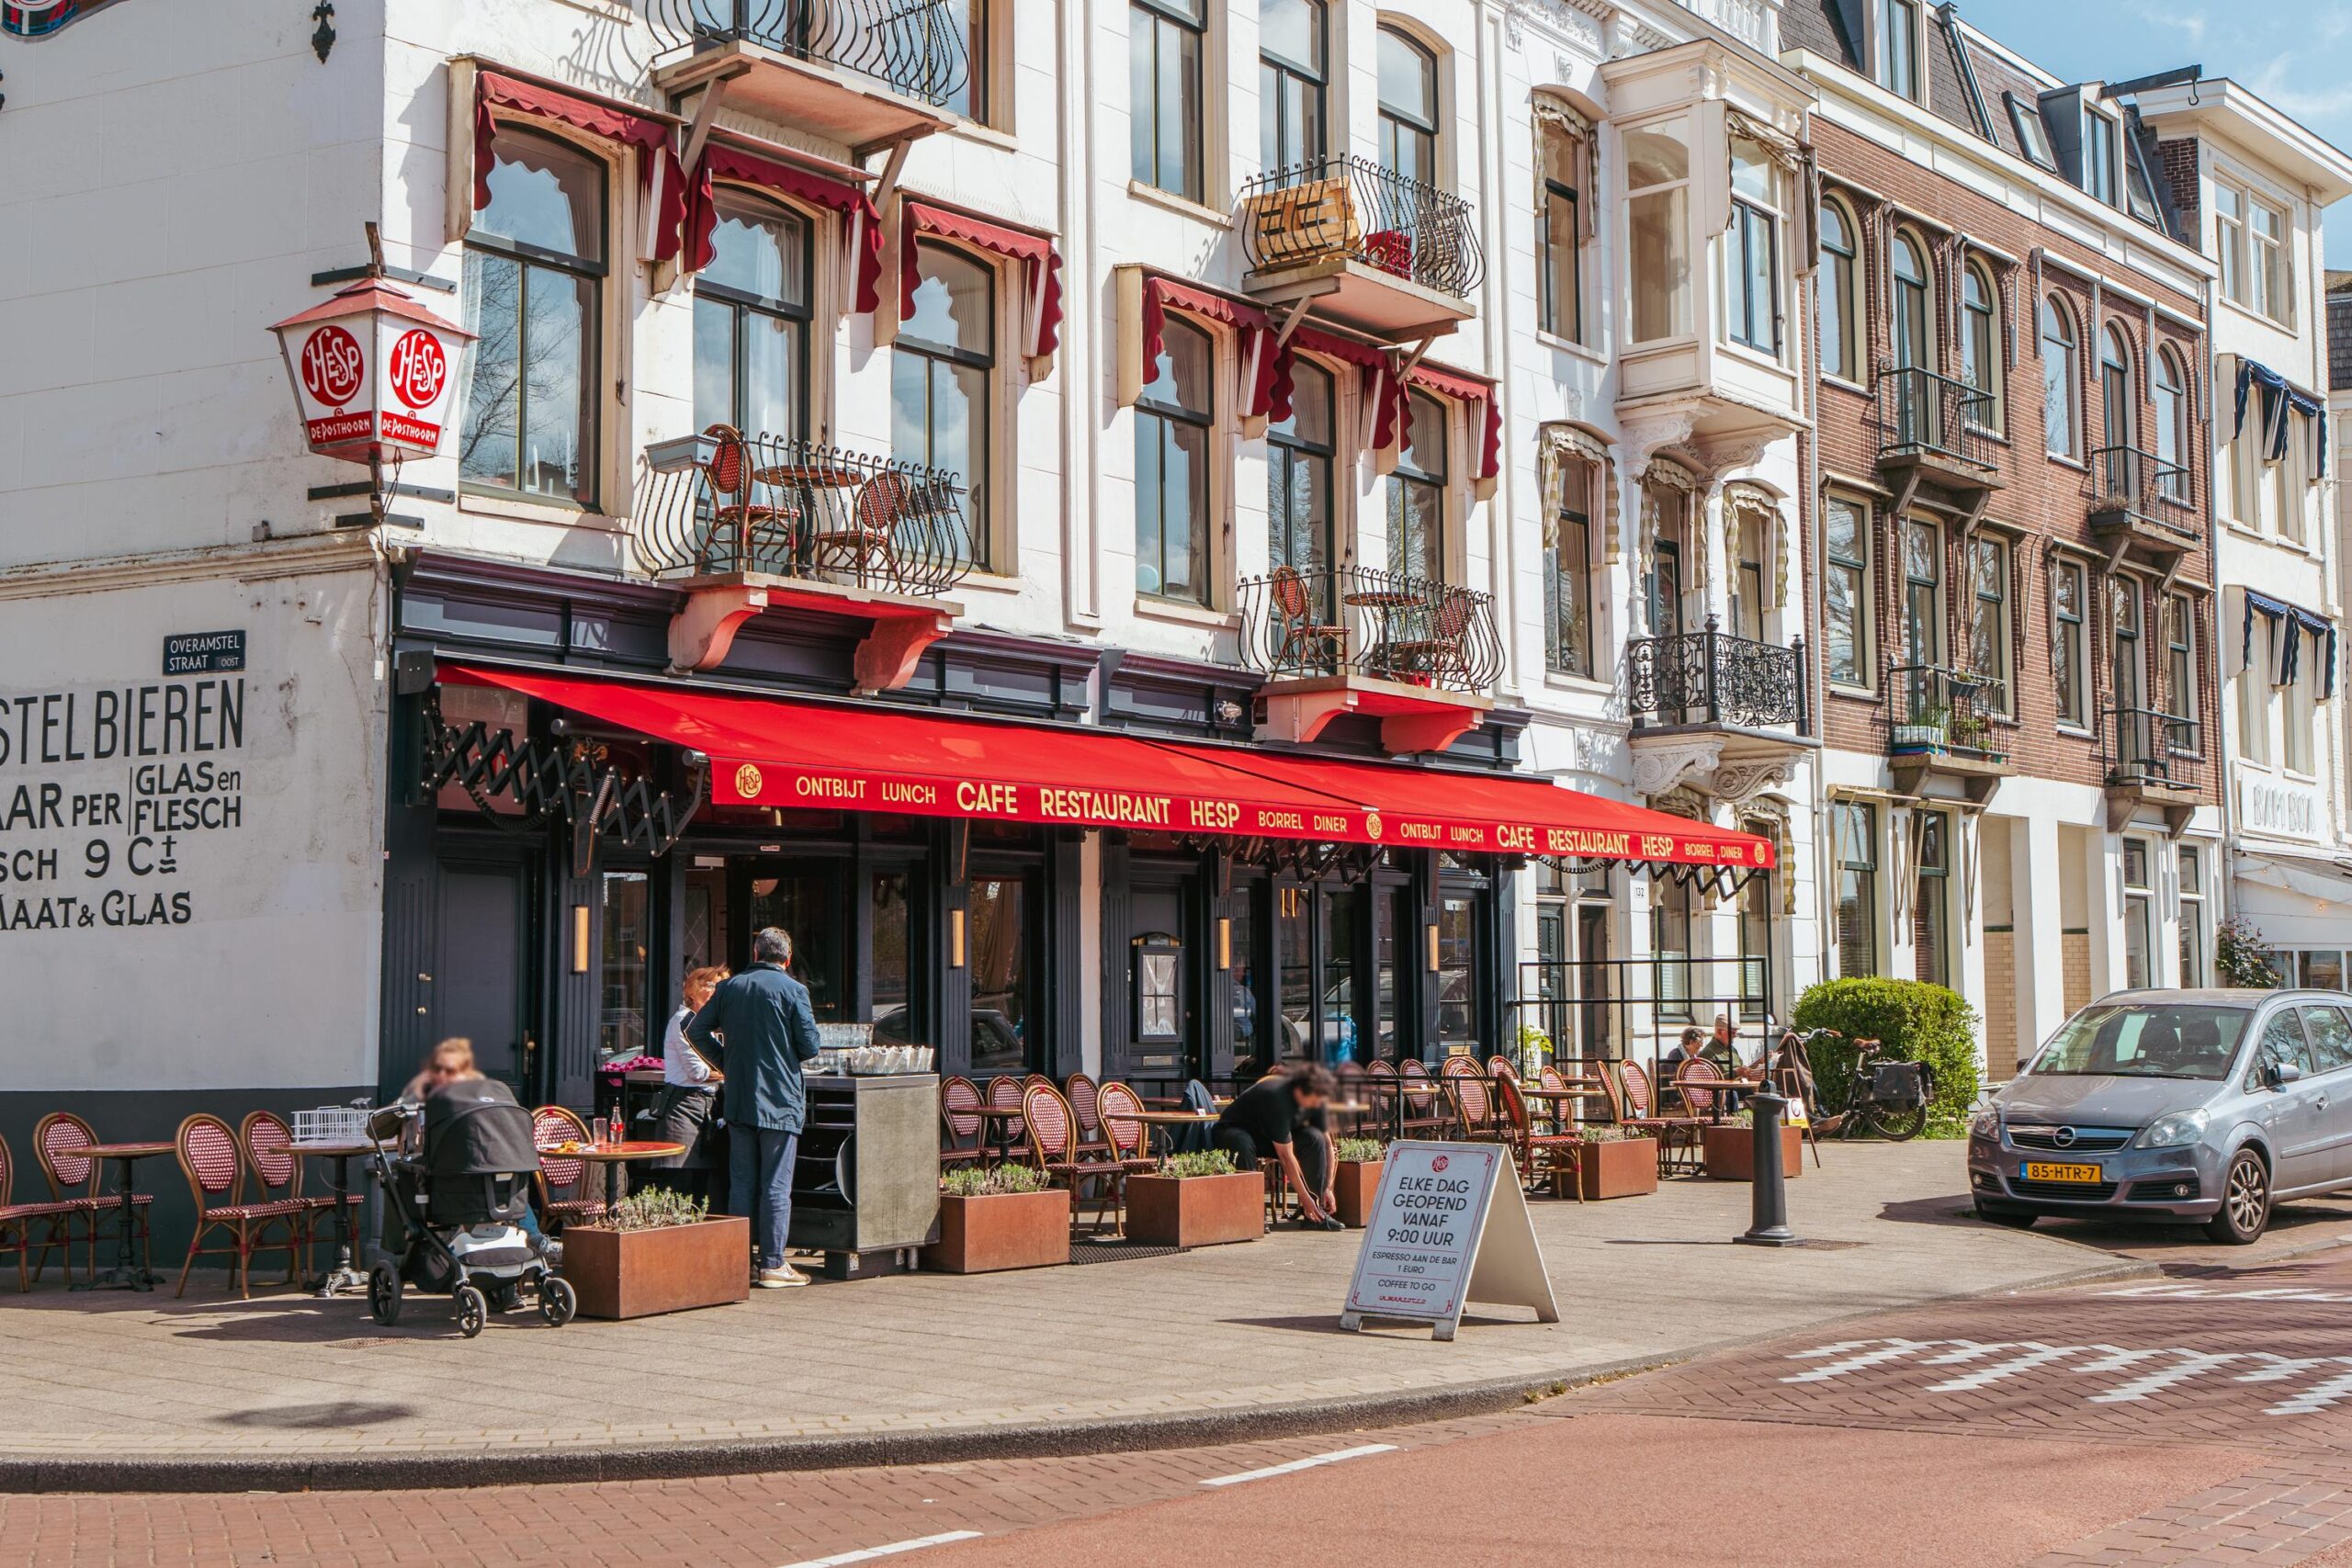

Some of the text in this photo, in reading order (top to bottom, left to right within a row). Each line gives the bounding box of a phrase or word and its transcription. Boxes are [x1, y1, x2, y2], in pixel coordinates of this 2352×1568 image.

[305, 327, 359, 400] HESP
[391, 331, 444, 406] HESP
[170, 635, 240, 654] OVERAMSTEL
[169, 655, 240, 671] STRAAT OOST
[0, 761, 241, 831] AR PER GLAS en
[796, 775, 1348, 833] ONTBIJT LUNCH CAFE RESTAURANT HESP BORREL DINER
[134, 795, 242, 836] FLESCH
[1400, 822, 1442, 840] ONTBIJT
[1450, 826, 1484, 843] LUNCH
[1497, 825, 1535, 849] CAFE
[1547, 829, 1630, 855] RESTAURANT
[1641, 835, 1674, 857] HESP
[1684, 842, 1715, 858] BORREL
[1720, 844, 1743, 860] DINER
[85, 839, 110, 879] 9
[0, 894, 77, 931] AAT
[2031, 1165, 2096, 1180] 85-HTR-7
[1398, 1177, 1470, 1193] ELKE DAG
[1393, 1193, 1467, 1211] GEOPEND
[1402, 1212, 1449, 1228] VANAF
[1387, 1228, 1454, 1247] 9:00 UUR
[1372, 1251, 1457, 1266] ESPRESSO AAN DE BAR
[1403, 1265, 1425, 1274] EURO
[1378, 1279, 1436, 1292] COFFEE TO GO
